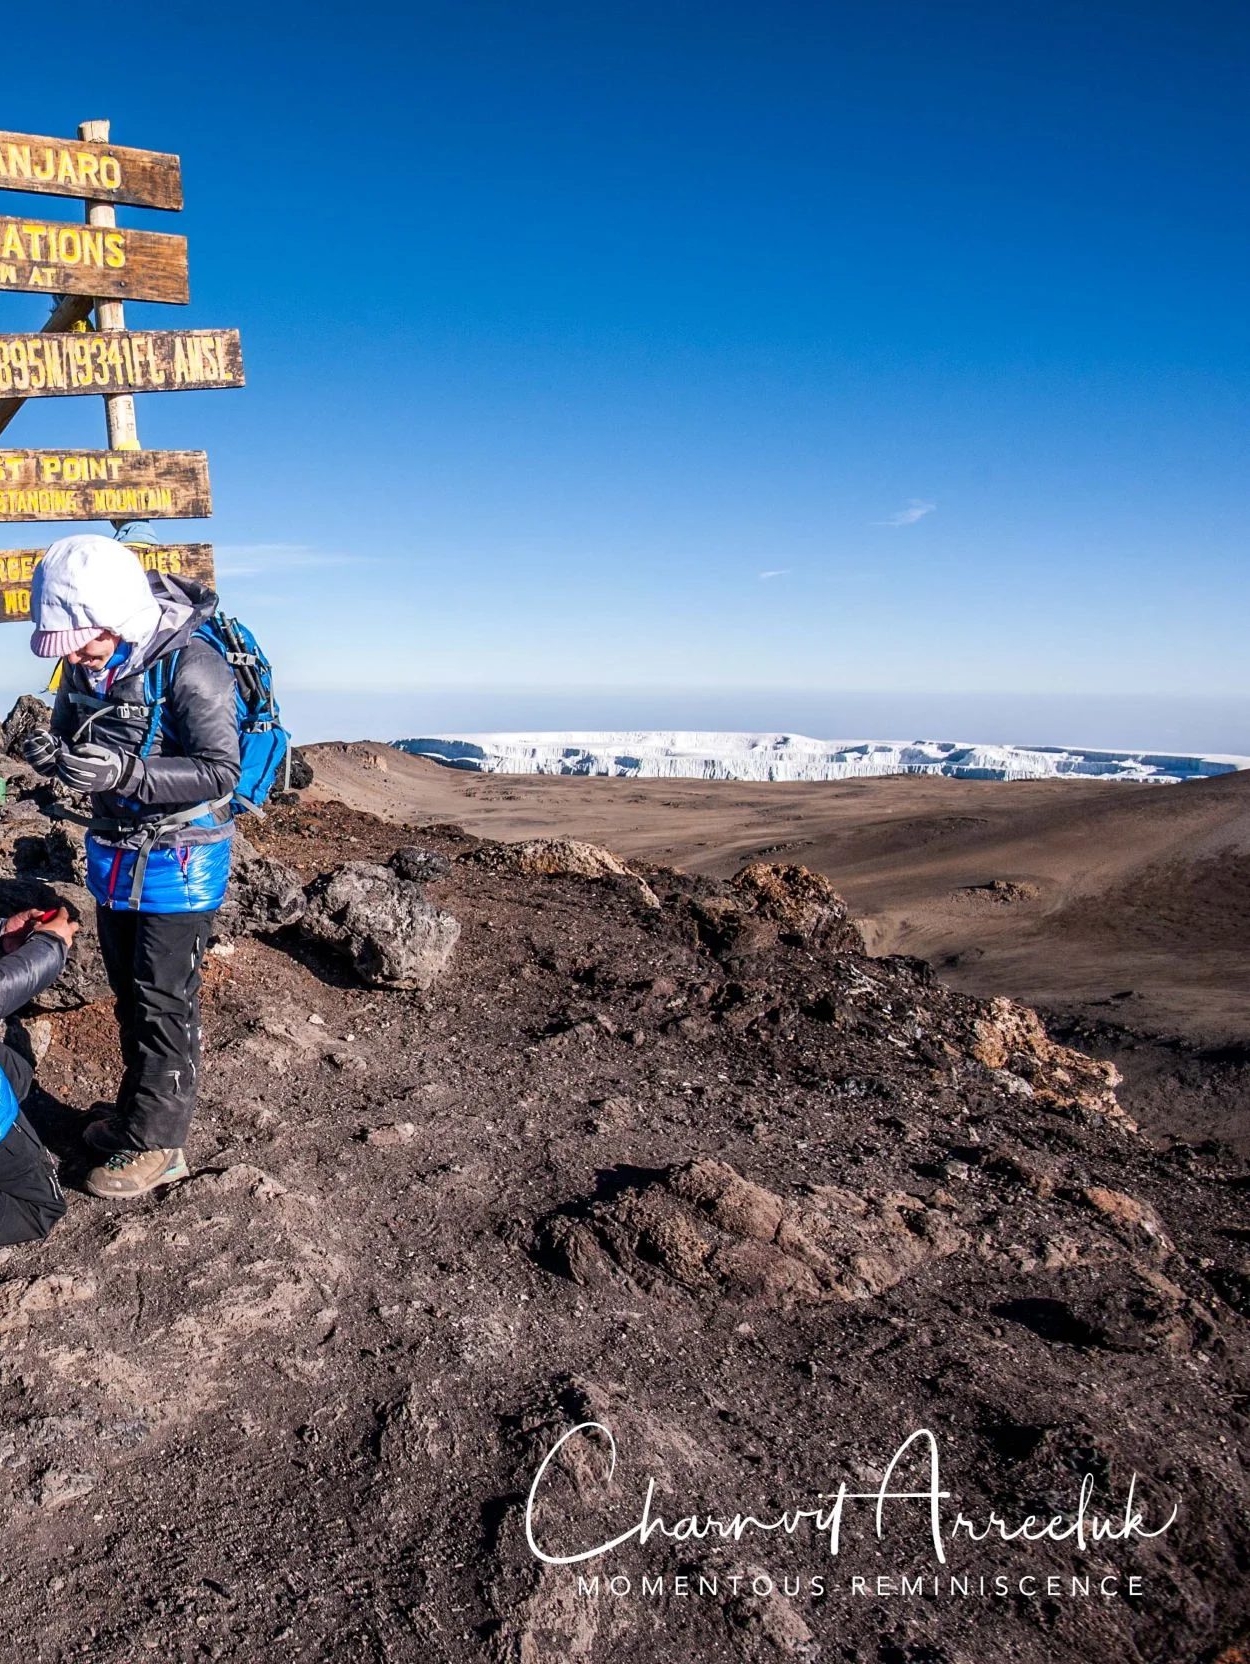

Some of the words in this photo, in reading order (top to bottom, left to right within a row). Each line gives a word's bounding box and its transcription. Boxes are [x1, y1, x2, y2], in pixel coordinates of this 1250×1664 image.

[28, 266, 58, 287] AT
[41, 457, 123, 481] POINT
[94, 488, 172, 512] MOUNTAIN
